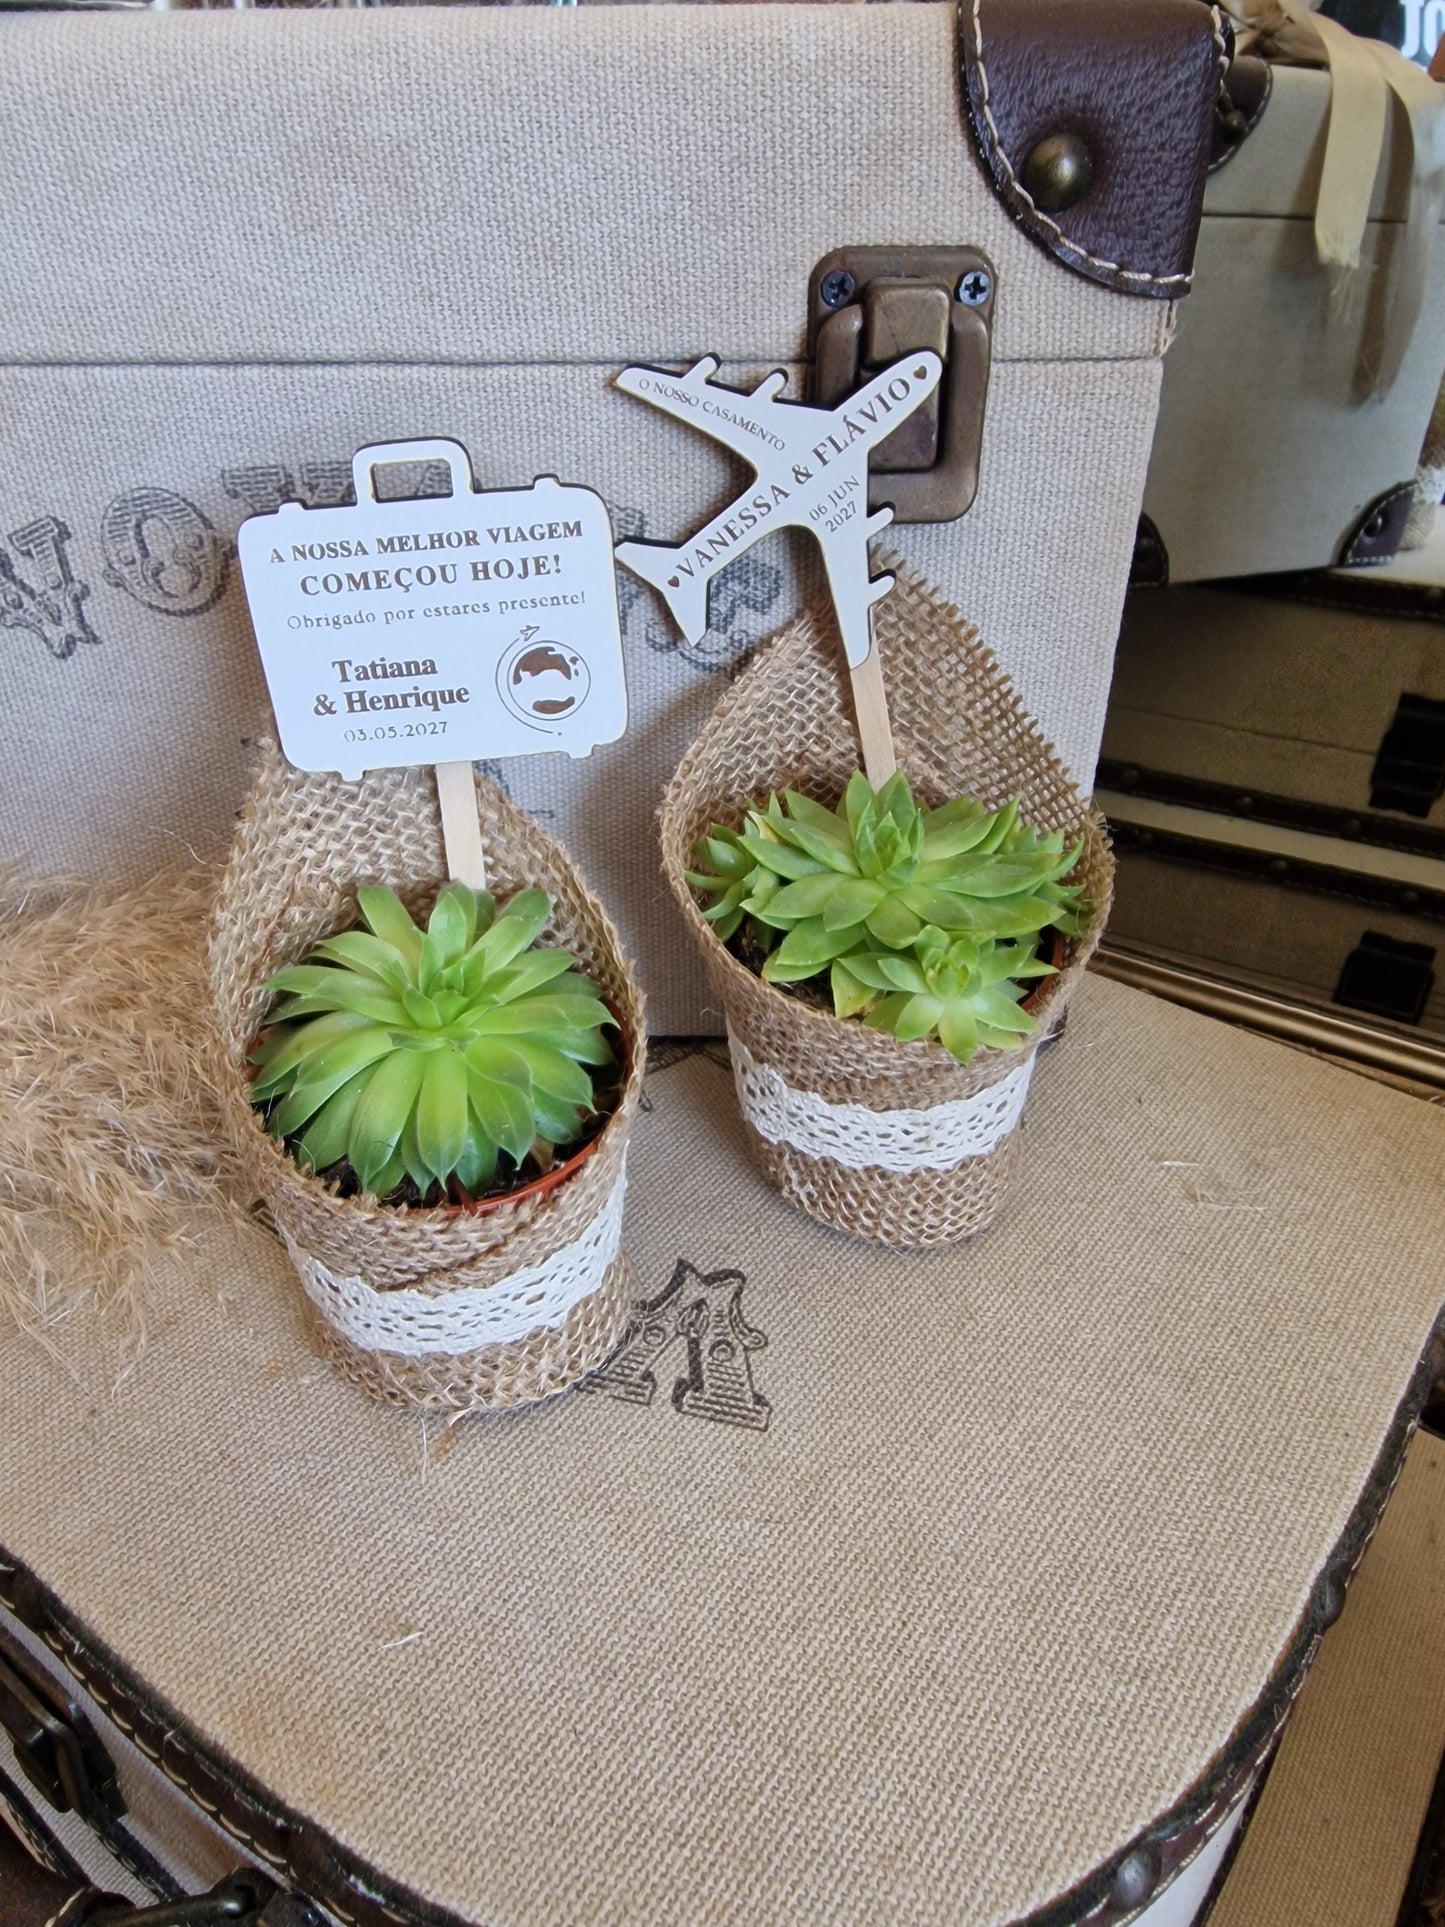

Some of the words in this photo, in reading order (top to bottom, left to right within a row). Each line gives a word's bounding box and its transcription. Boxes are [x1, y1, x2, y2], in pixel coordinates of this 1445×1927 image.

[638, 377, 651, 391] O
[652, 383, 700, 407] NOSSO
[701, 400, 786, 452] CASAMENTO
[675, 483, 791, 578] VANESSA
[791, 463, 814, 485] &
[811, 377, 911, 468] FLÁVIO
[809, 501, 829, 523] 06
[829, 474, 860, 505] JUN
[825, 500, 858, 533] 2027
[270, 548, 285, 563] A
[292, 539, 370, 562] NOSSA
[376, 529, 480, 554] MELHOR
[486, 520, 584, 544] VIAGEM
[300, 563, 458, 596] COMEÇOU
[469, 554, 562, 582] HOJE!
[287, 610, 377, 630] Obrigado
[384, 606, 416, 625] por
[422, 601, 491, 619] estares
[499, 590, 587, 615] presente!
[331, 656, 438, 684] Tatiana
[313, 693, 337, 716] &
[343, 686, 471, 714] Henrique
[343, 721, 449, 743] 03.05.2027
